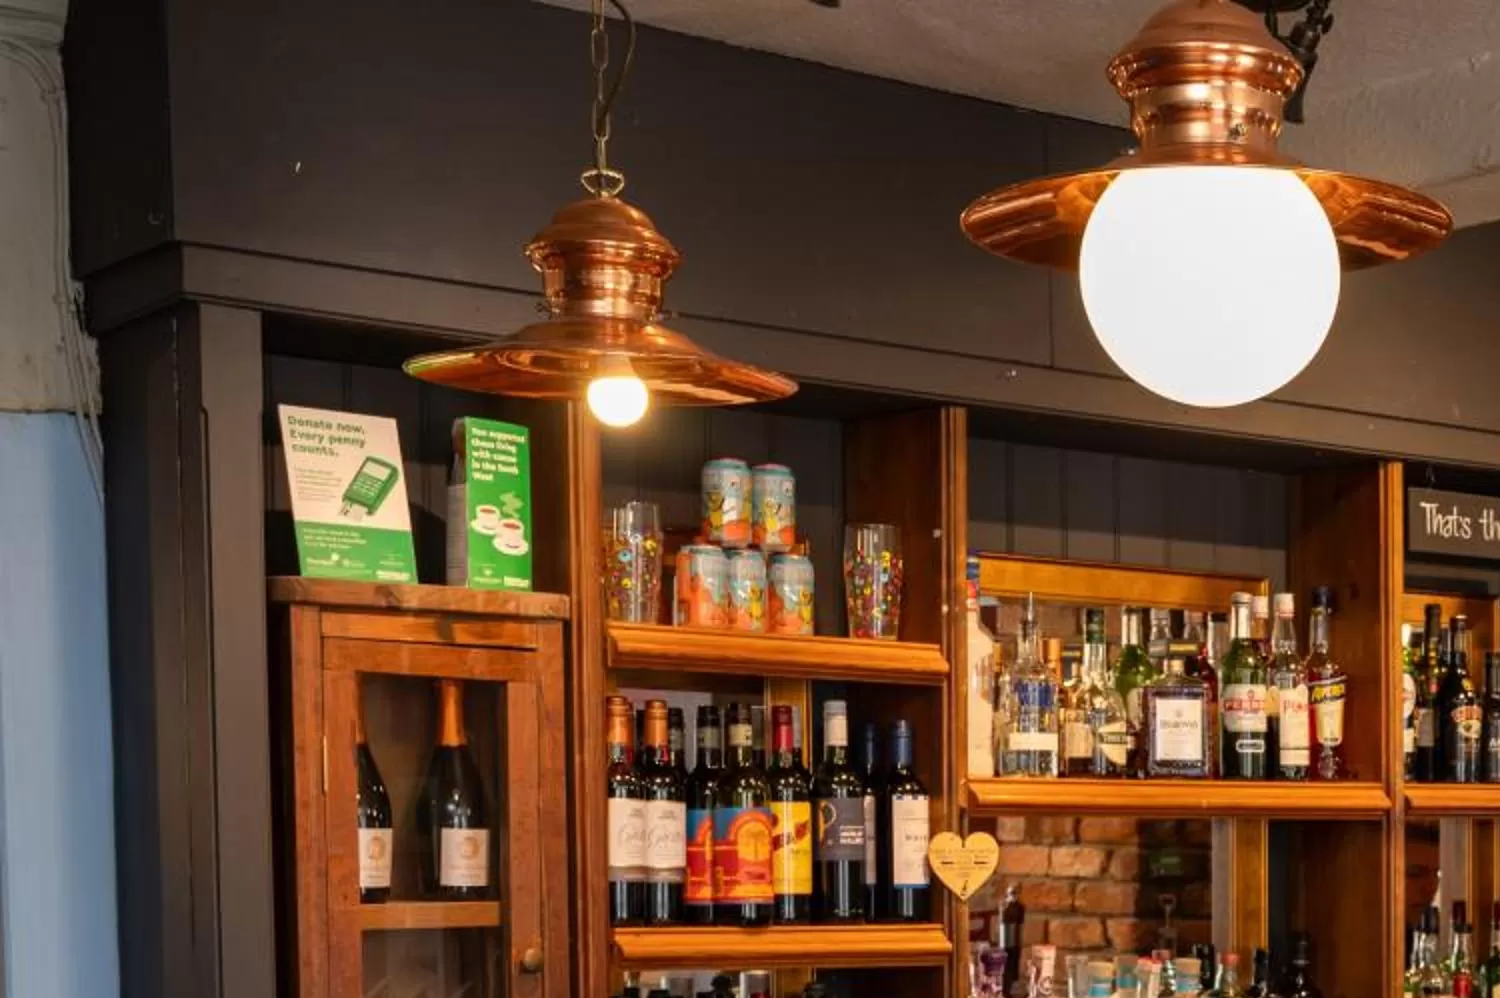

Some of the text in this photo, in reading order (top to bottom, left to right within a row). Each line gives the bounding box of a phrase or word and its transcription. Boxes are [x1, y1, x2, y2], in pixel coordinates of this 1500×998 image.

[287, 415, 365, 434] Donate now.
[290, 428, 365, 449] Every penny
[291, 443, 340, 457] counts.
